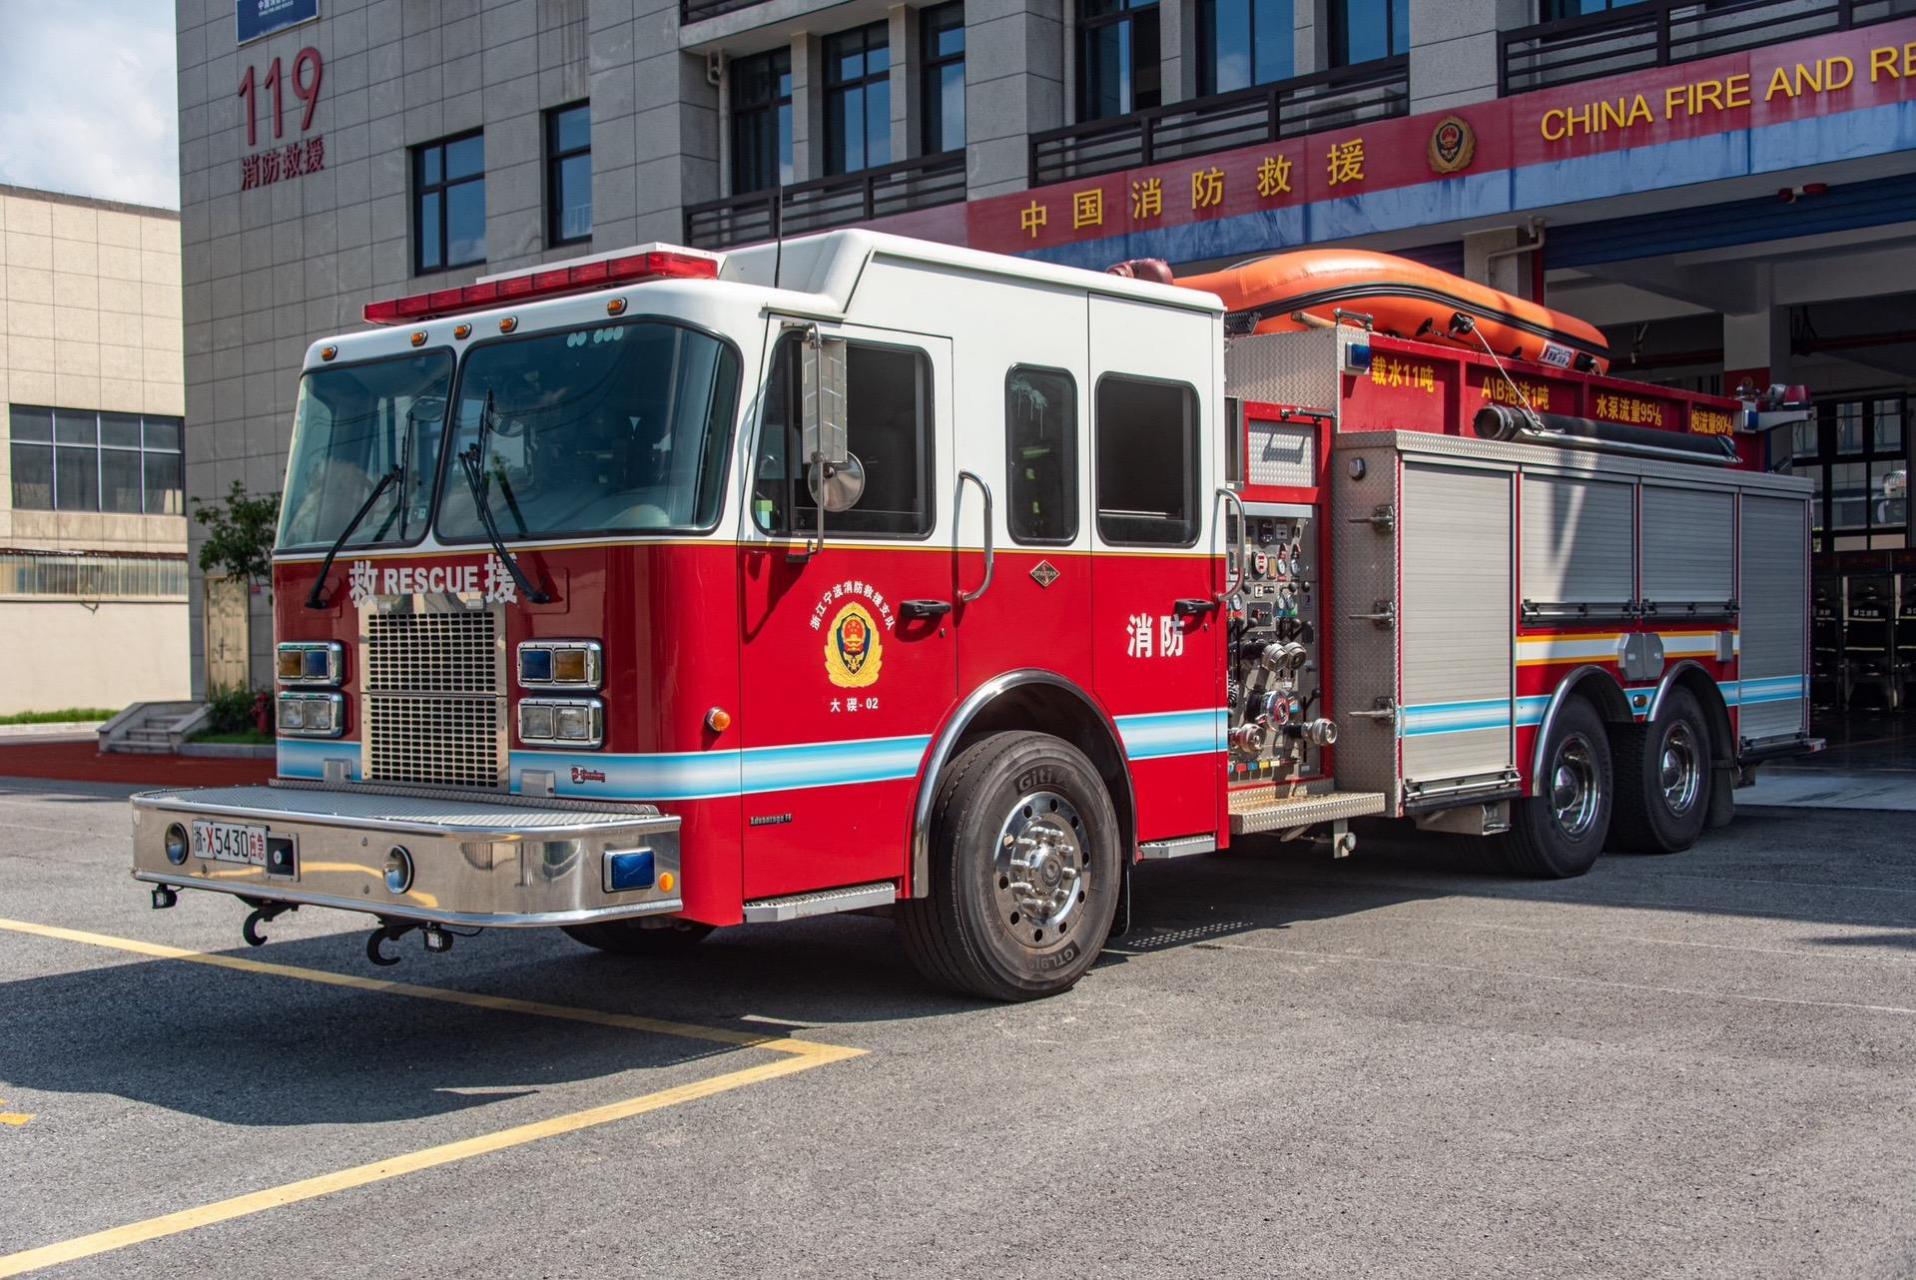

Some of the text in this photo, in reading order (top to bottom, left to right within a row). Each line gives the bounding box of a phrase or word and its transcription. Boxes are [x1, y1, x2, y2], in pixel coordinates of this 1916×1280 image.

[239, 46, 324, 146] 119
[1540, 94, 1655, 141] CHINA
[1665, 73, 1751, 120] FIRE
[1764, 56, 1855, 102] AND
[241, 134, 325, 191] 消防救援
[1020, 138, 1365, 239] 中国消防救援
[1371, 355, 1435, 394] 载水11吨
[348, 552, 518, 608] 救 RESCUE 援
[1126, 612, 1185, 658] 消防
